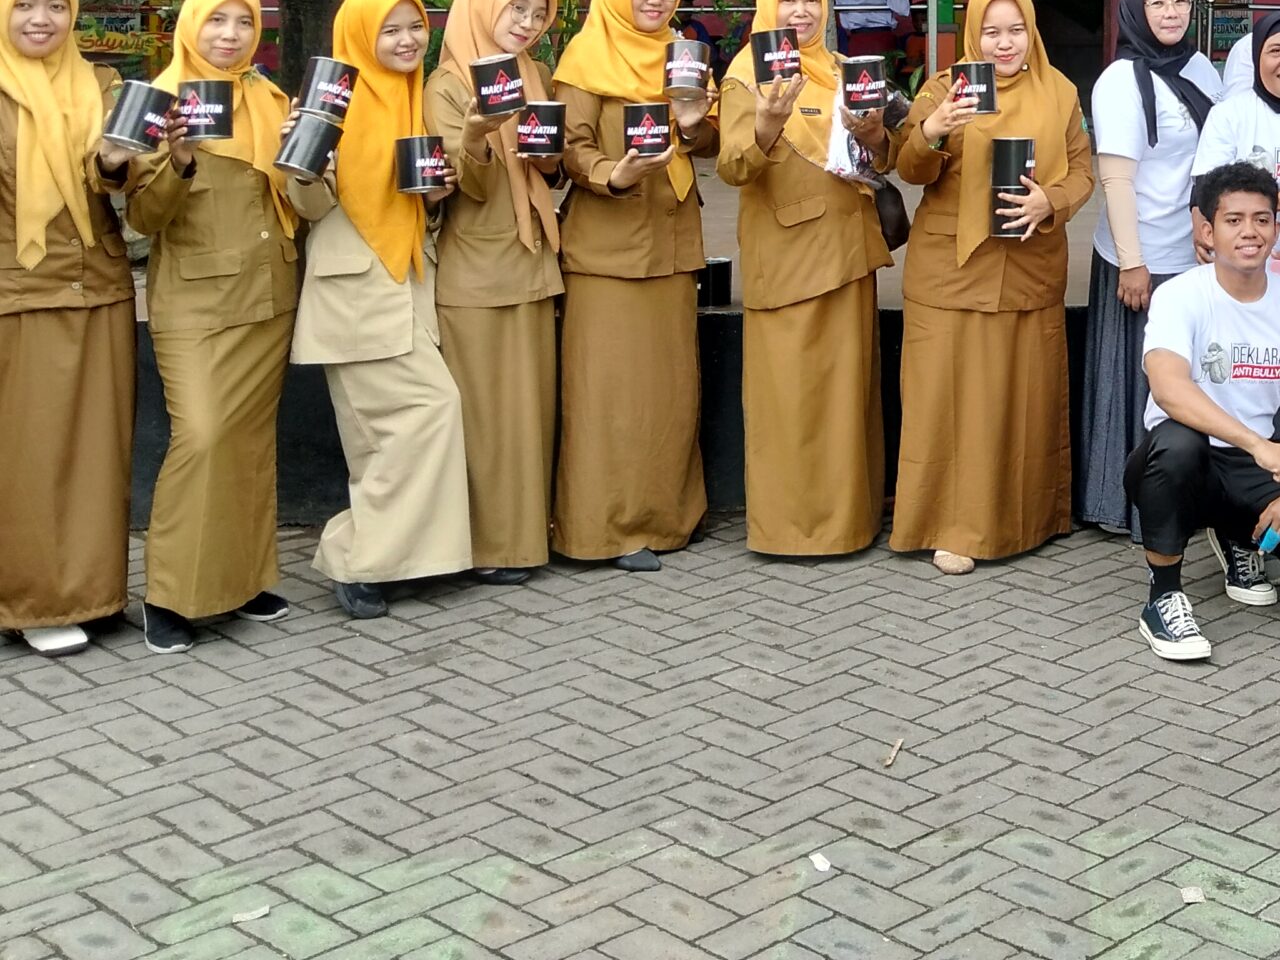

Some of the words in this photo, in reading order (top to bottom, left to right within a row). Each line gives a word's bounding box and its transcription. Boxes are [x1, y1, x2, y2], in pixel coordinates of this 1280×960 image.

[481, 84, 503, 95] MAKI
[846, 82, 865, 91] MAKI
[963, 83, 987, 93] JATIM
[193, 103, 223, 114] JATIM
[532, 125, 558, 134] JATIM
[627, 126, 647, 136] MAKI
[415, 157, 438, 167] MAKI
[1233, 366, 1253, 377] ANTI
